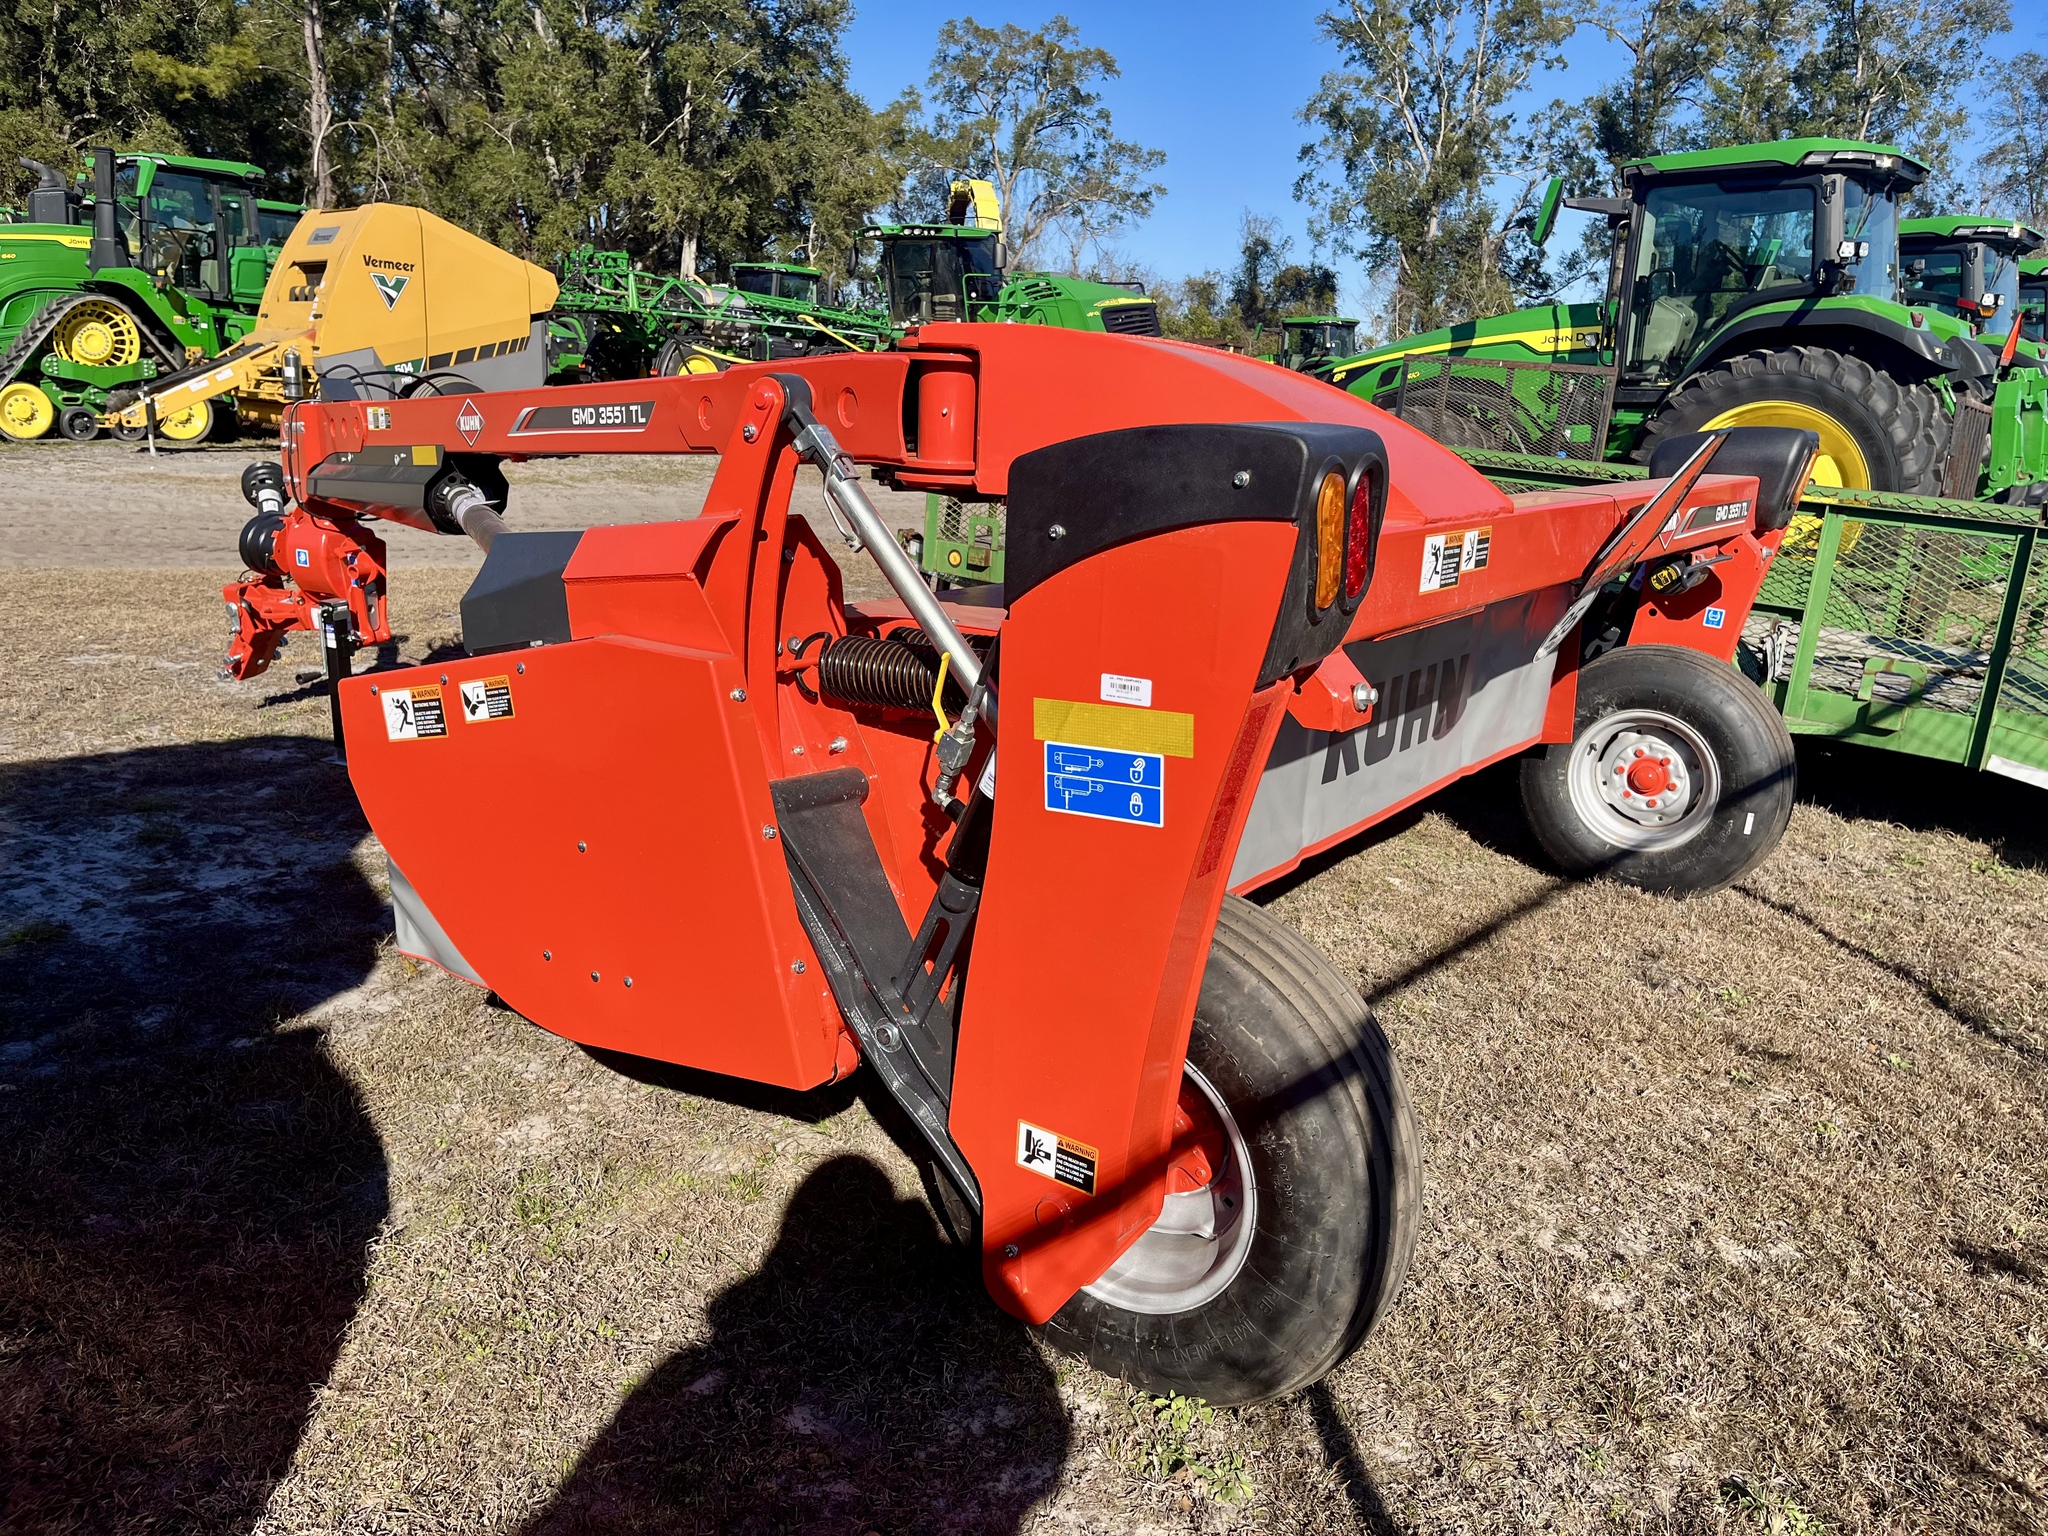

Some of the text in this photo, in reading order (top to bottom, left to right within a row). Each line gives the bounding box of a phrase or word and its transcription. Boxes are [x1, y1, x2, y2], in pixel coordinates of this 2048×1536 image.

[362, 254, 415, 272] Vermeer
[1541, 334, 1573, 344] JOHN
[394, 362, 414, 374] 504
[459, 414, 481, 432] KUHN
[571, 405, 647, 426] GMD 3551 TL
[1715, 502, 1748, 522] GMD 3551 TL
[488, 679, 508, 688] WARNING
[416, 688, 440, 698] WARNING
[1066, 1142, 1095, 1159] WARNING
